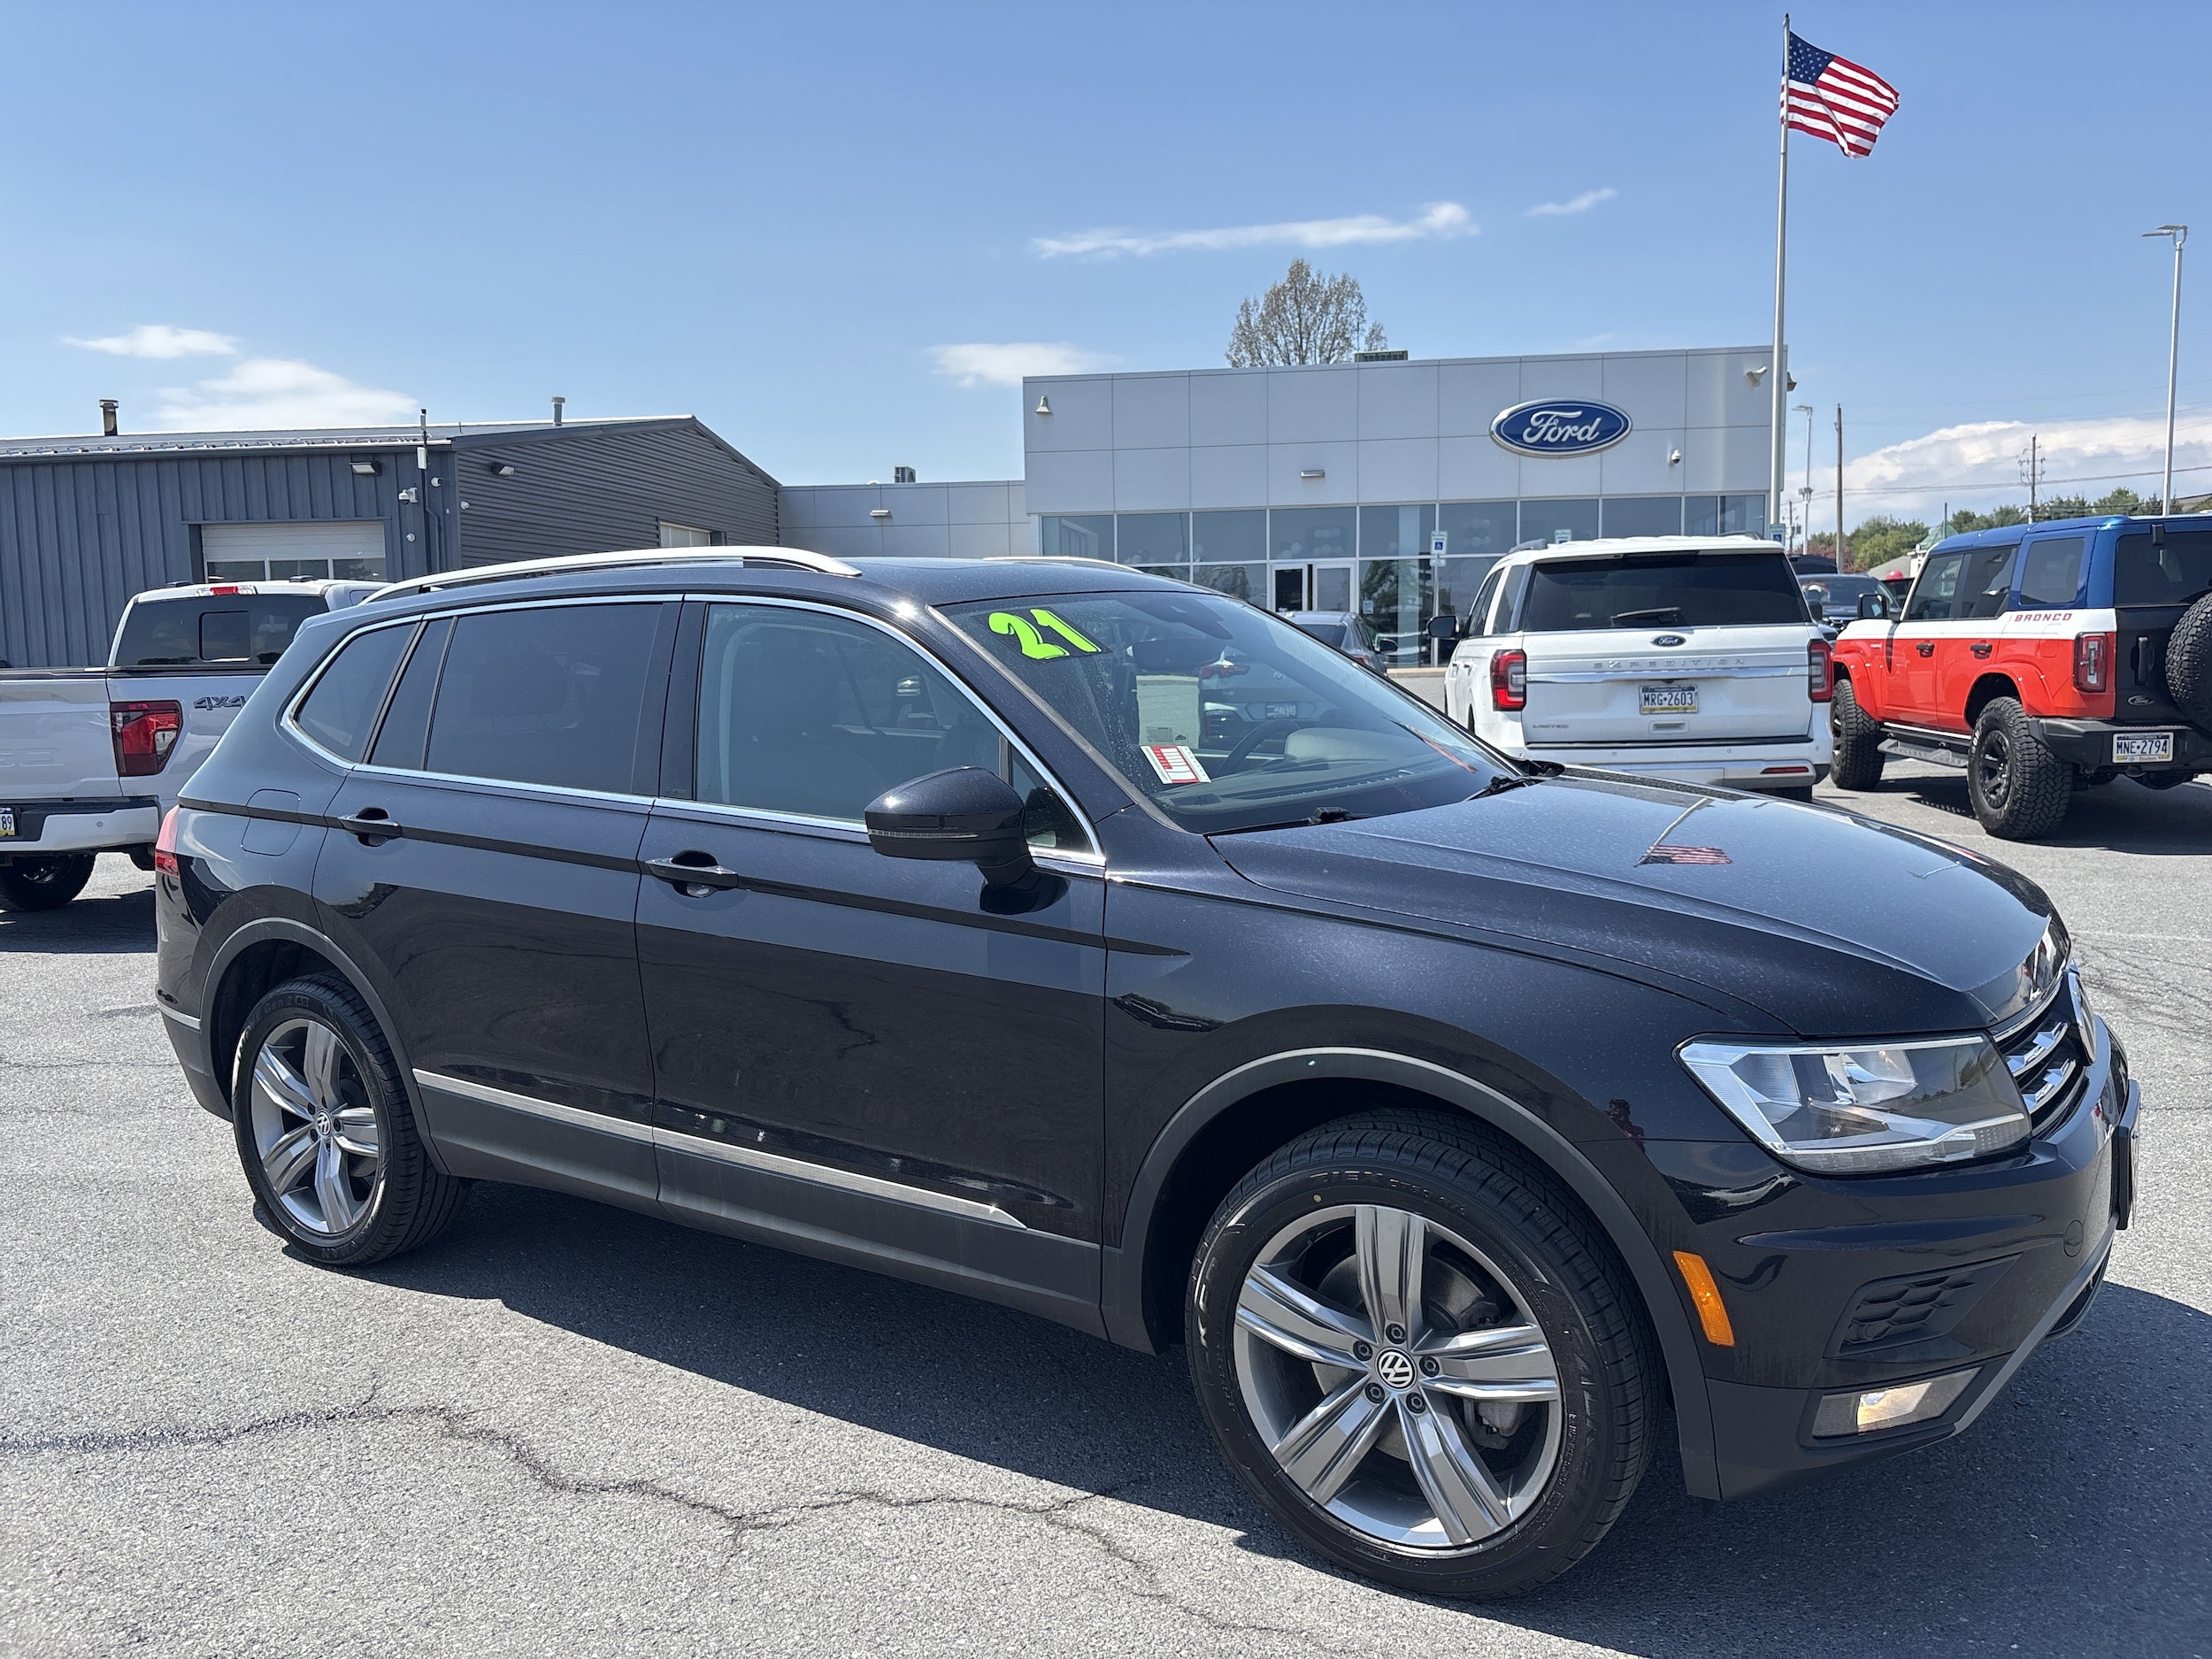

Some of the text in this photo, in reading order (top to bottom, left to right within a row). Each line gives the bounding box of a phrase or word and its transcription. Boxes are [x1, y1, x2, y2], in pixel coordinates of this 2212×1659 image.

[1522, 410, 1603, 444] Ford
[2014, 613, 2073, 622] BRONCO
[988, 608, 1102, 660] 21
[1658, 635, 1680, 646] Ford
[1593, 658, 1745, 670] EXPEDITION
[264, 999, 284, 1014] Gen
